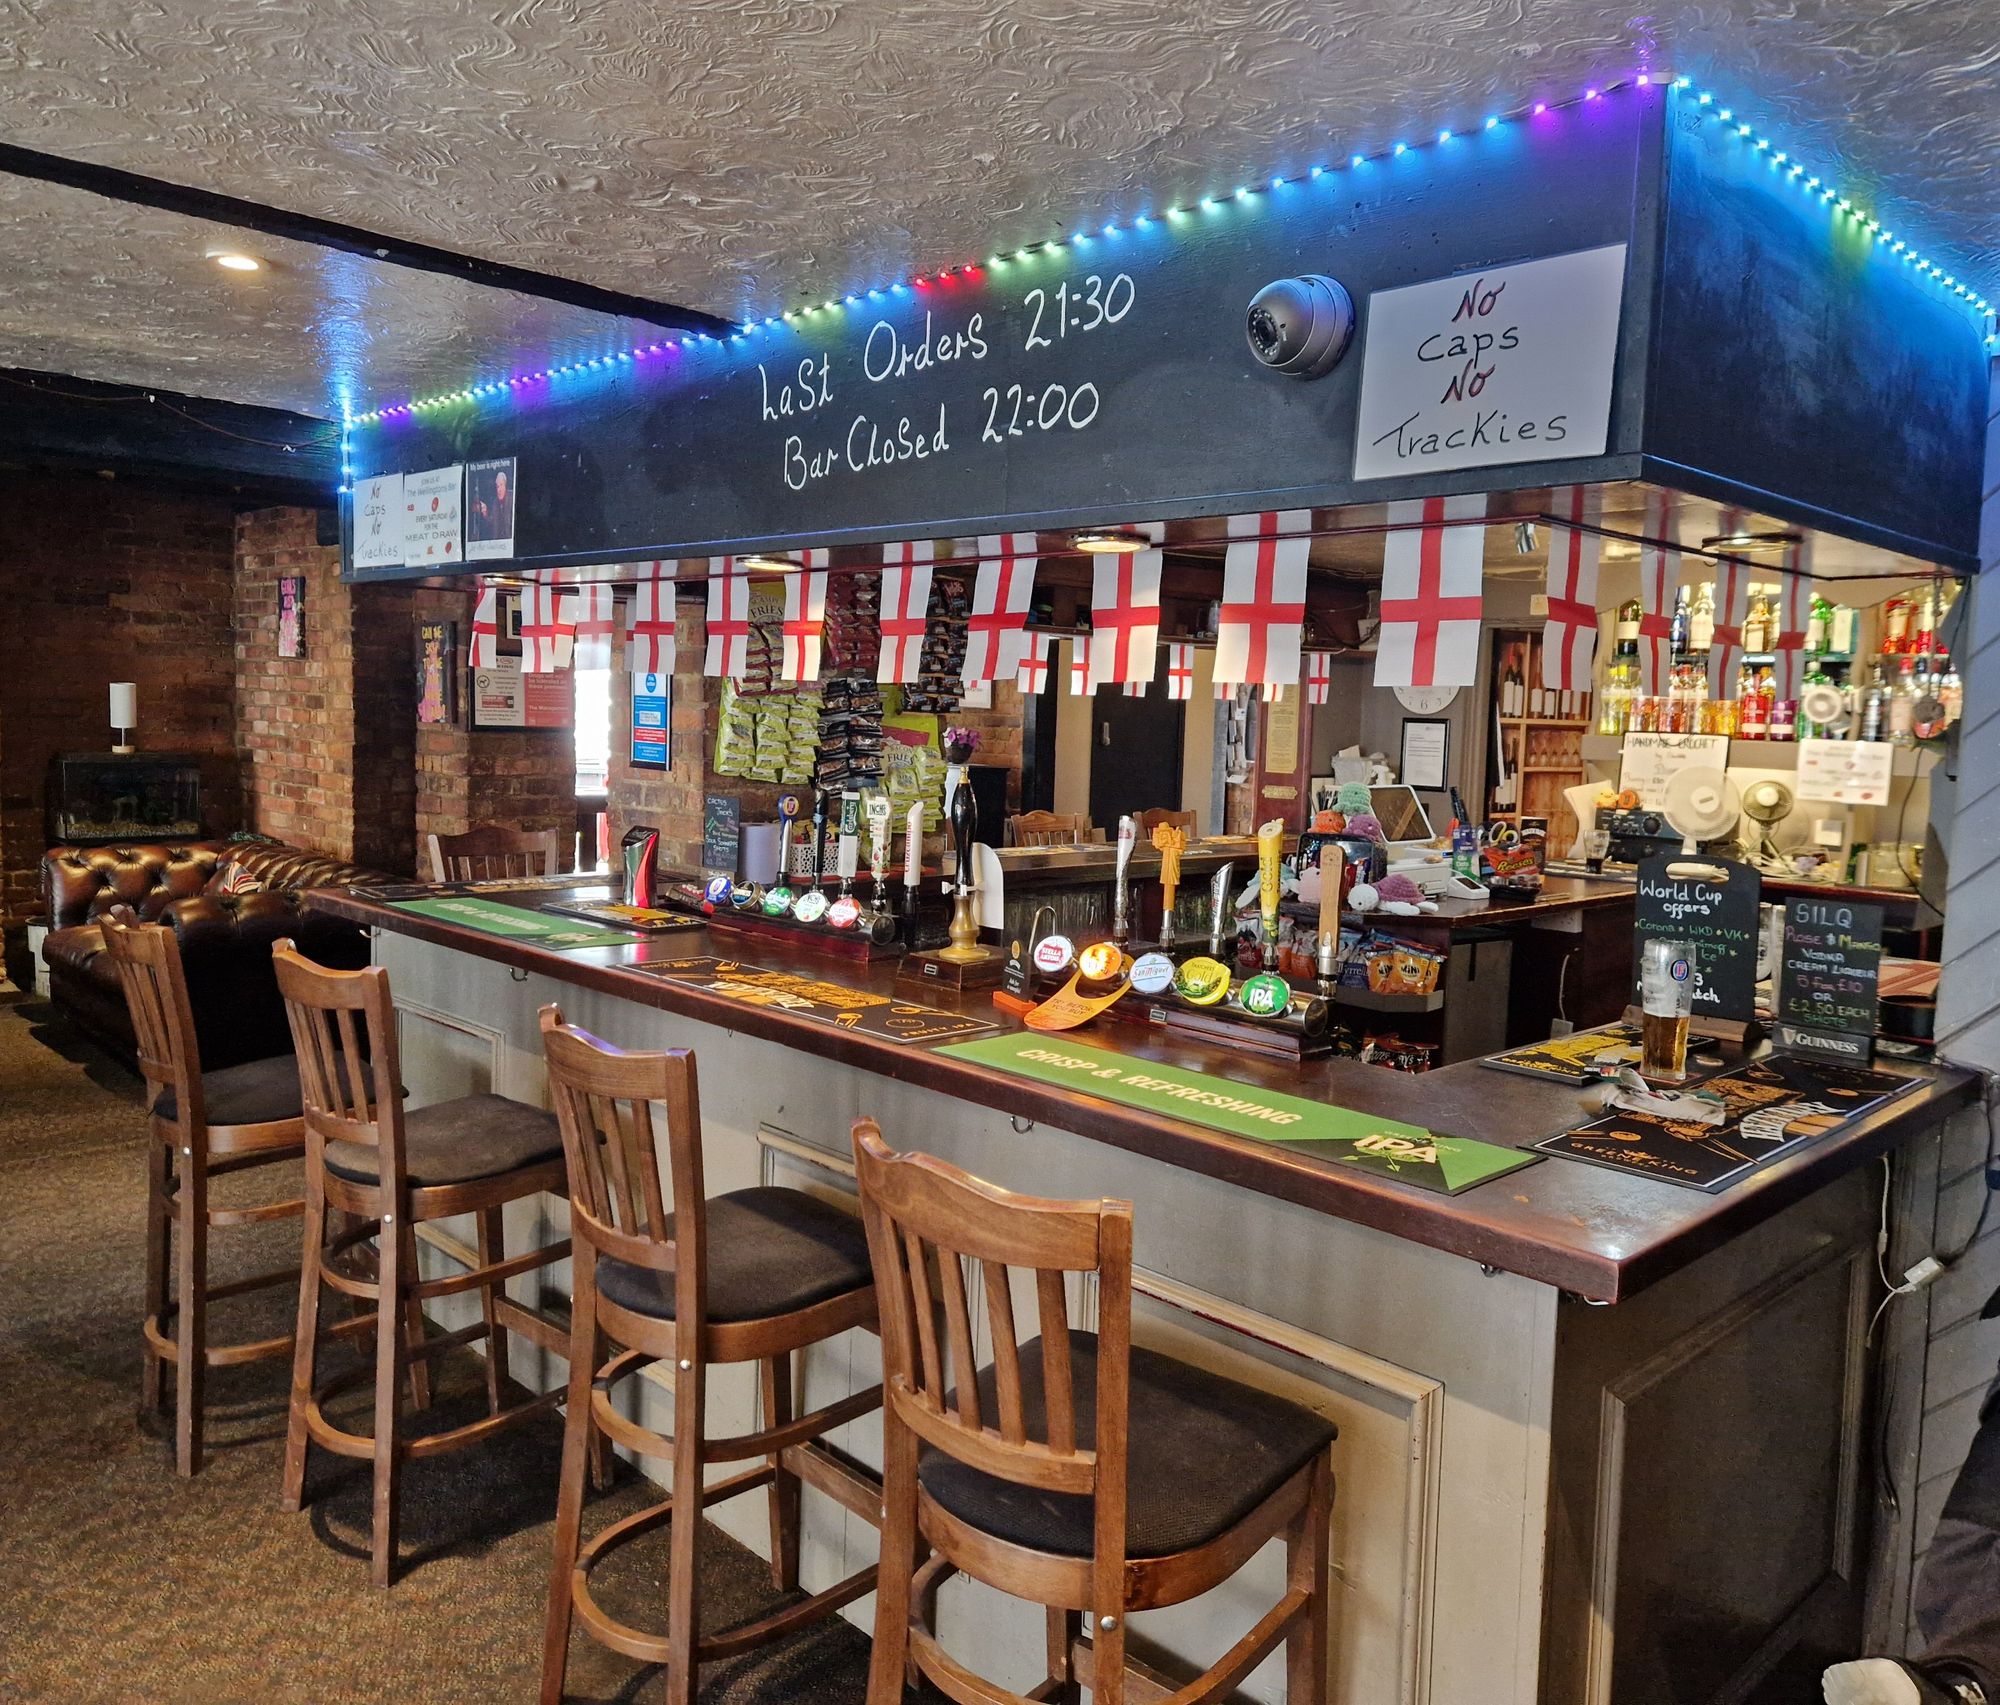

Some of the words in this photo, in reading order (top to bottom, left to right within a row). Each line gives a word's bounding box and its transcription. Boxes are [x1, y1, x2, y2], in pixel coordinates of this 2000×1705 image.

[1451, 278, 1506, 323] No
[1023, 273, 1136, 352] 21:30
[1440, 358, 1496, 404] No
[784, 435, 839, 490] Bar
[982, 382, 1100, 444] 22:00
[432, 529, 457, 539] DRAW
[750, 605, 784, 617] FRIES
[1421, 699, 1428, 710] 6
[1640, 880, 1688, 898] World
[1696, 884, 1722, 904] Cup
[1663, 903, 1710, 919] offers
[1796, 903, 1852, 929] SILQ
[1639, 918, 1675, 932] Corona
[1724, 928, 1743, 940] VK
[1701, 949, 1717, 960] Ice
[1186, 968, 1214, 983] Gold
[1797, 974, 1809, 988] 5
[1837, 979, 1864, 993] £10
[1249, 988, 1275, 1007] IPA
[1789, 997, 1834, 1015] £2.50
[1812, 992, 1834, 1002] OR
[901, 1026, 949, 1037] FRUITY
[952, 1023, 976, 1031] IPA
[1804, 1014, 1848, 1028] SHOTS
[1796, 1033, 1859, 1053] GUINNESS
[1016, 1048, 1099, 1070] CRISP
[1090, 1068, 1122, 1079] &
[1119, 1075, 1303, 1125] REFRESHING
[1352, 1134, 1437, 1164] IPA
[1648, 1160, 1699, 1175] KING
